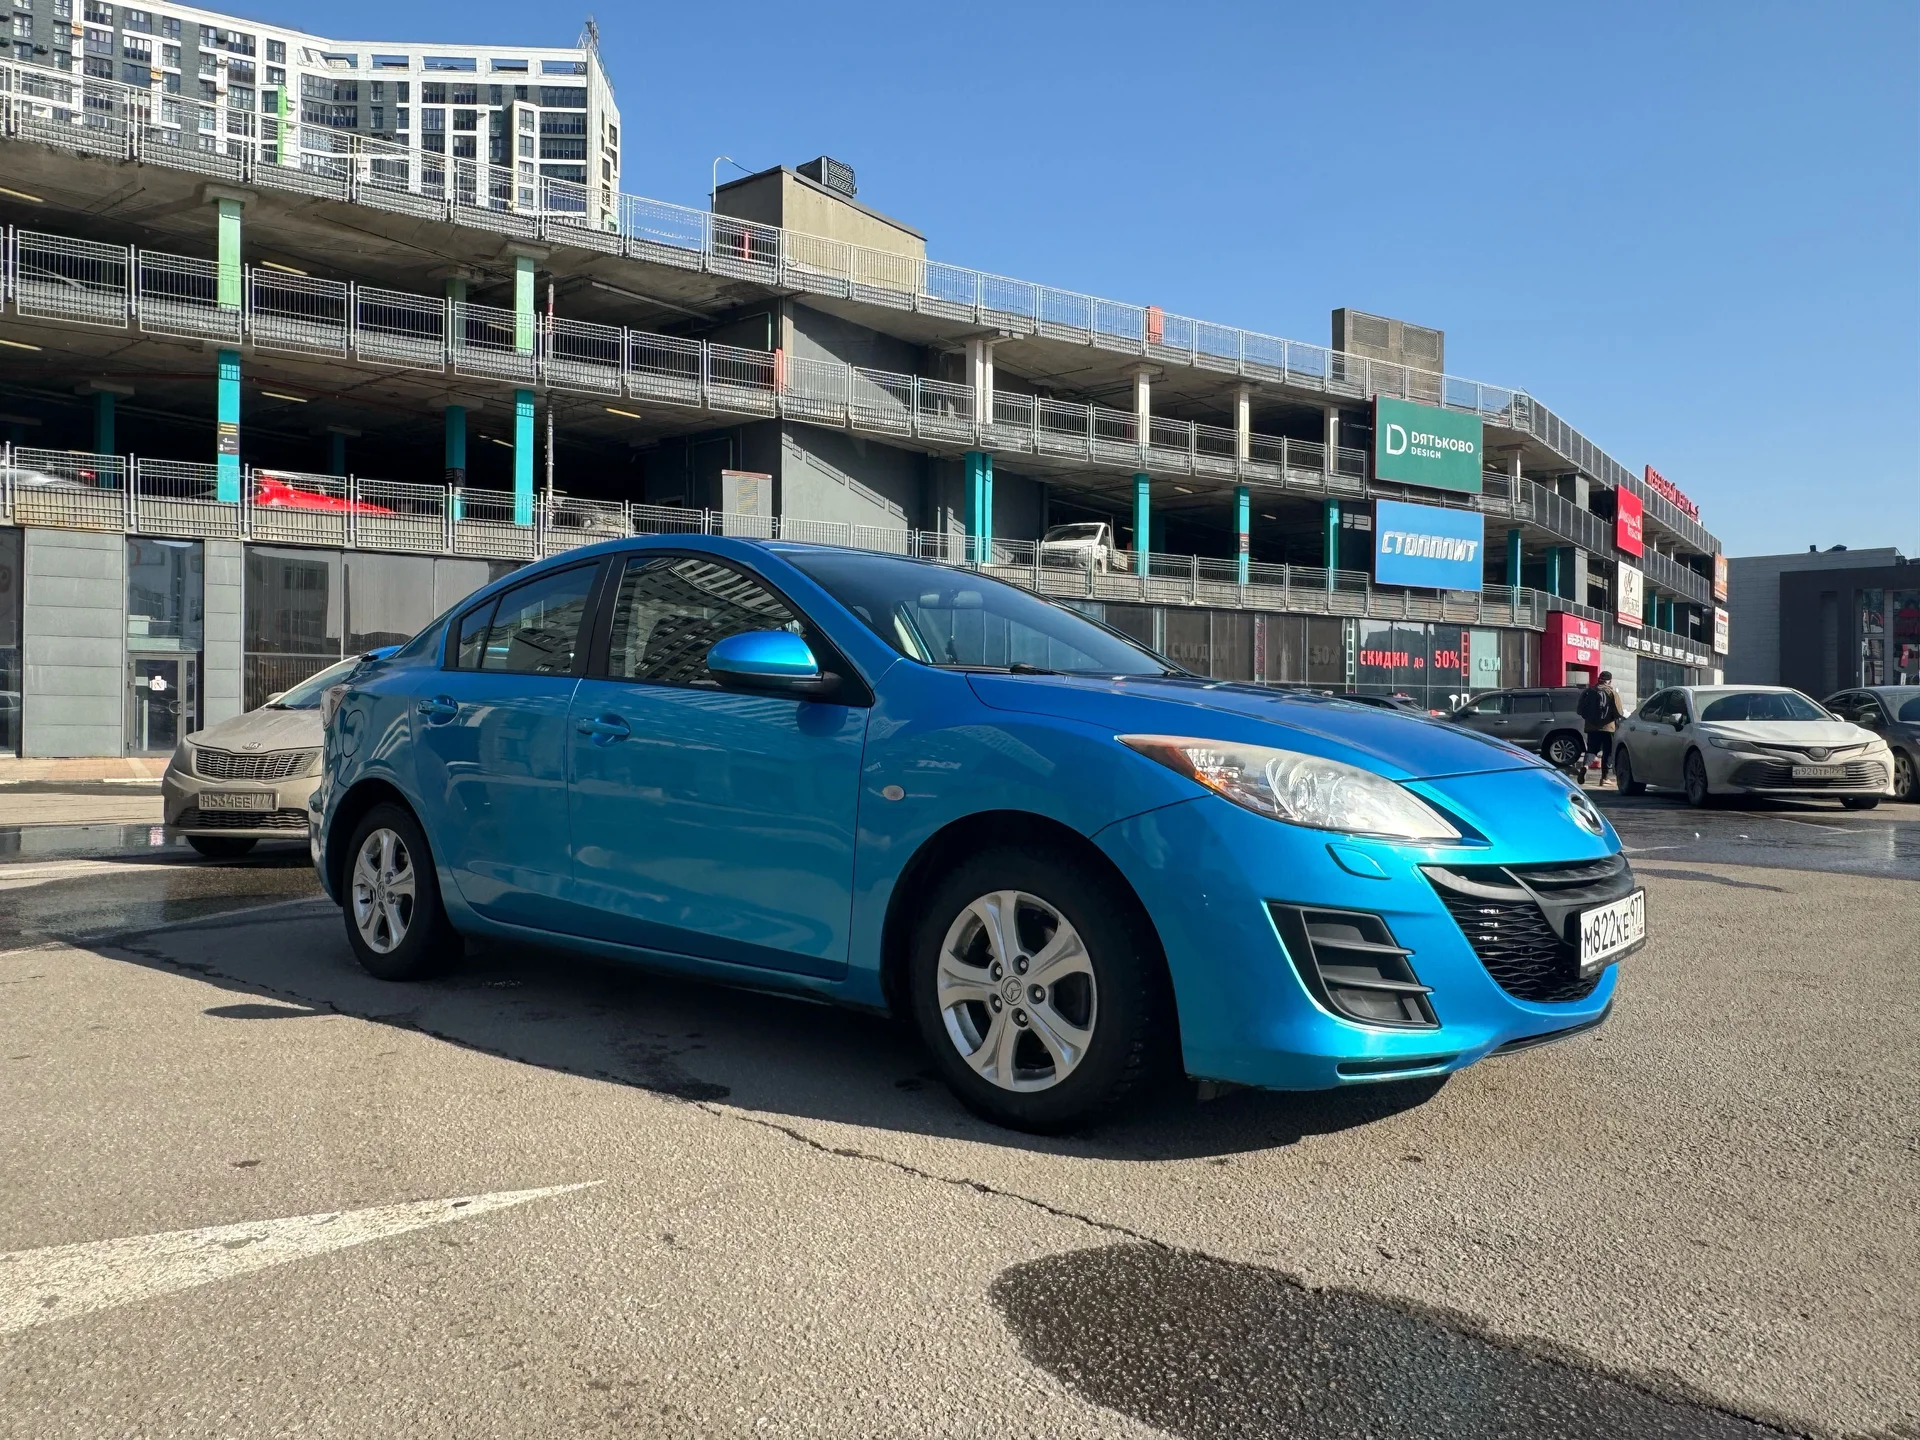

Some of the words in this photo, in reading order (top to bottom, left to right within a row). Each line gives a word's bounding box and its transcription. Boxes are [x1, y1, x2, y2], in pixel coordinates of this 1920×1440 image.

[1411, 446, 1442, 459] DESIGN
[1360, 650, 1408, 669] СКИДКИ
[1435, 650, 1459, 669] 50%
[1630, 895, 1642, 925] 977
